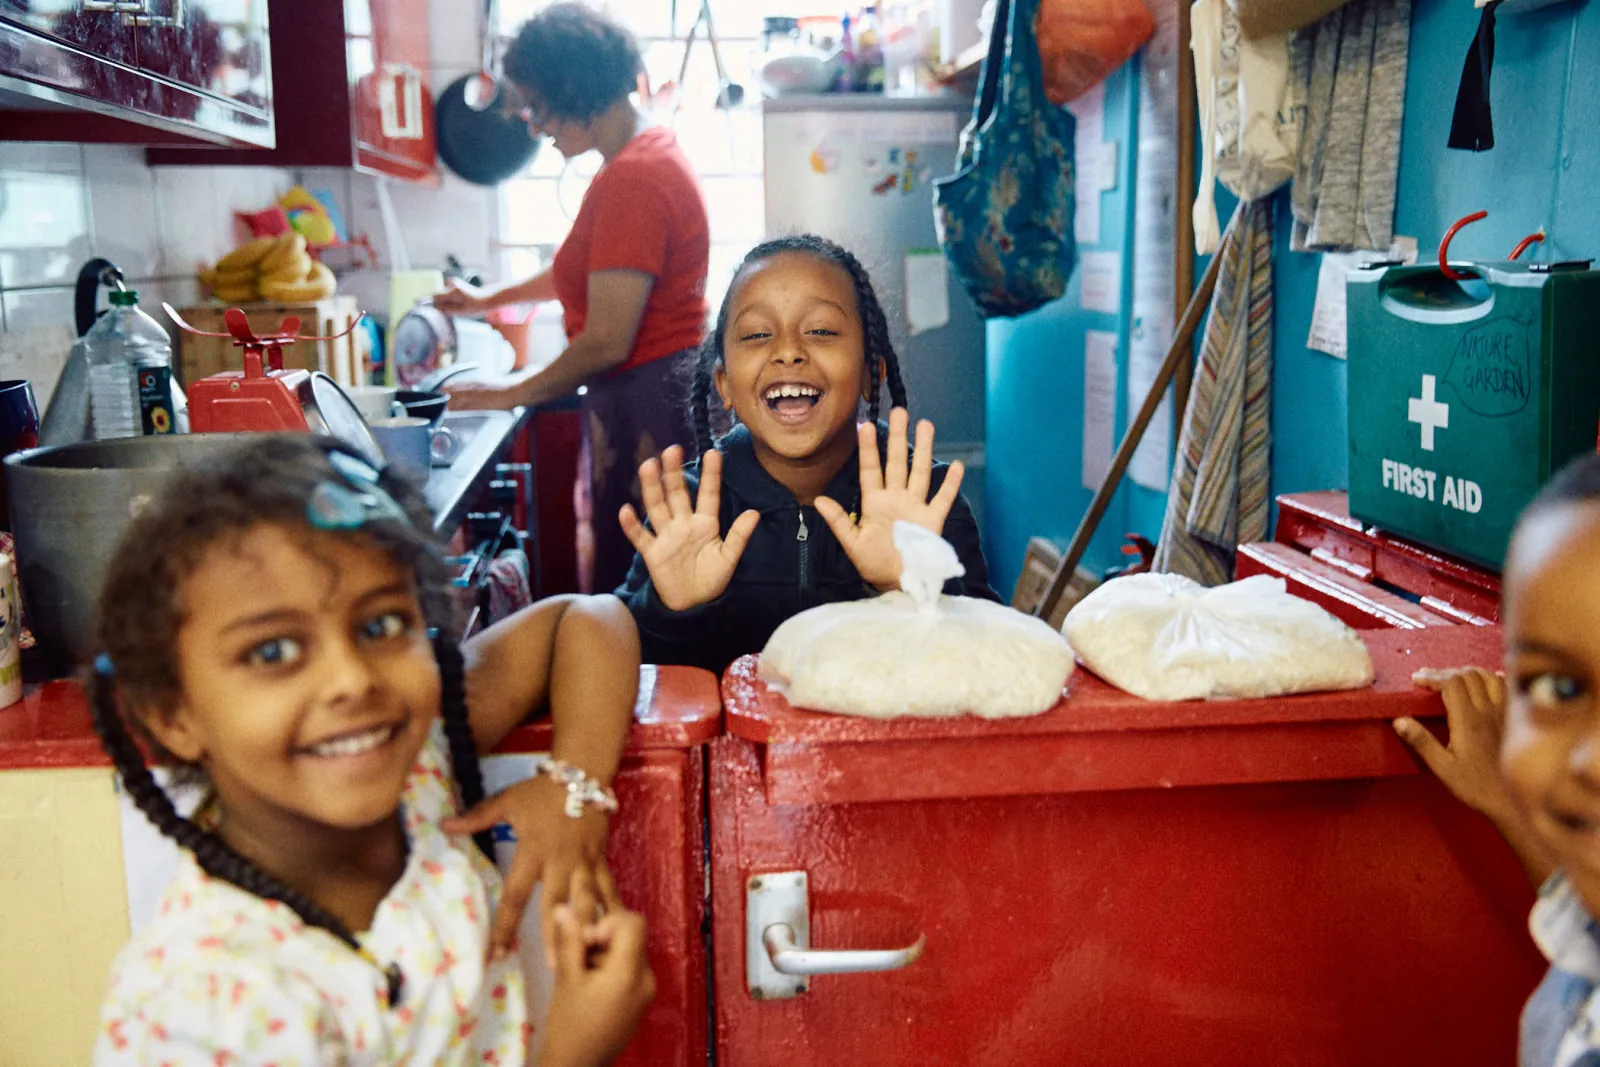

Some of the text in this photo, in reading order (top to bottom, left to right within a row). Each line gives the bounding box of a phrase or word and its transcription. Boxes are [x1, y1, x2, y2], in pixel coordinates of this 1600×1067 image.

[1461, 332, 1517, 365] NATURE
[1463, 365, 1525, 400] GARDEN
[1382, 458, 1482, 514] FIRST AID
